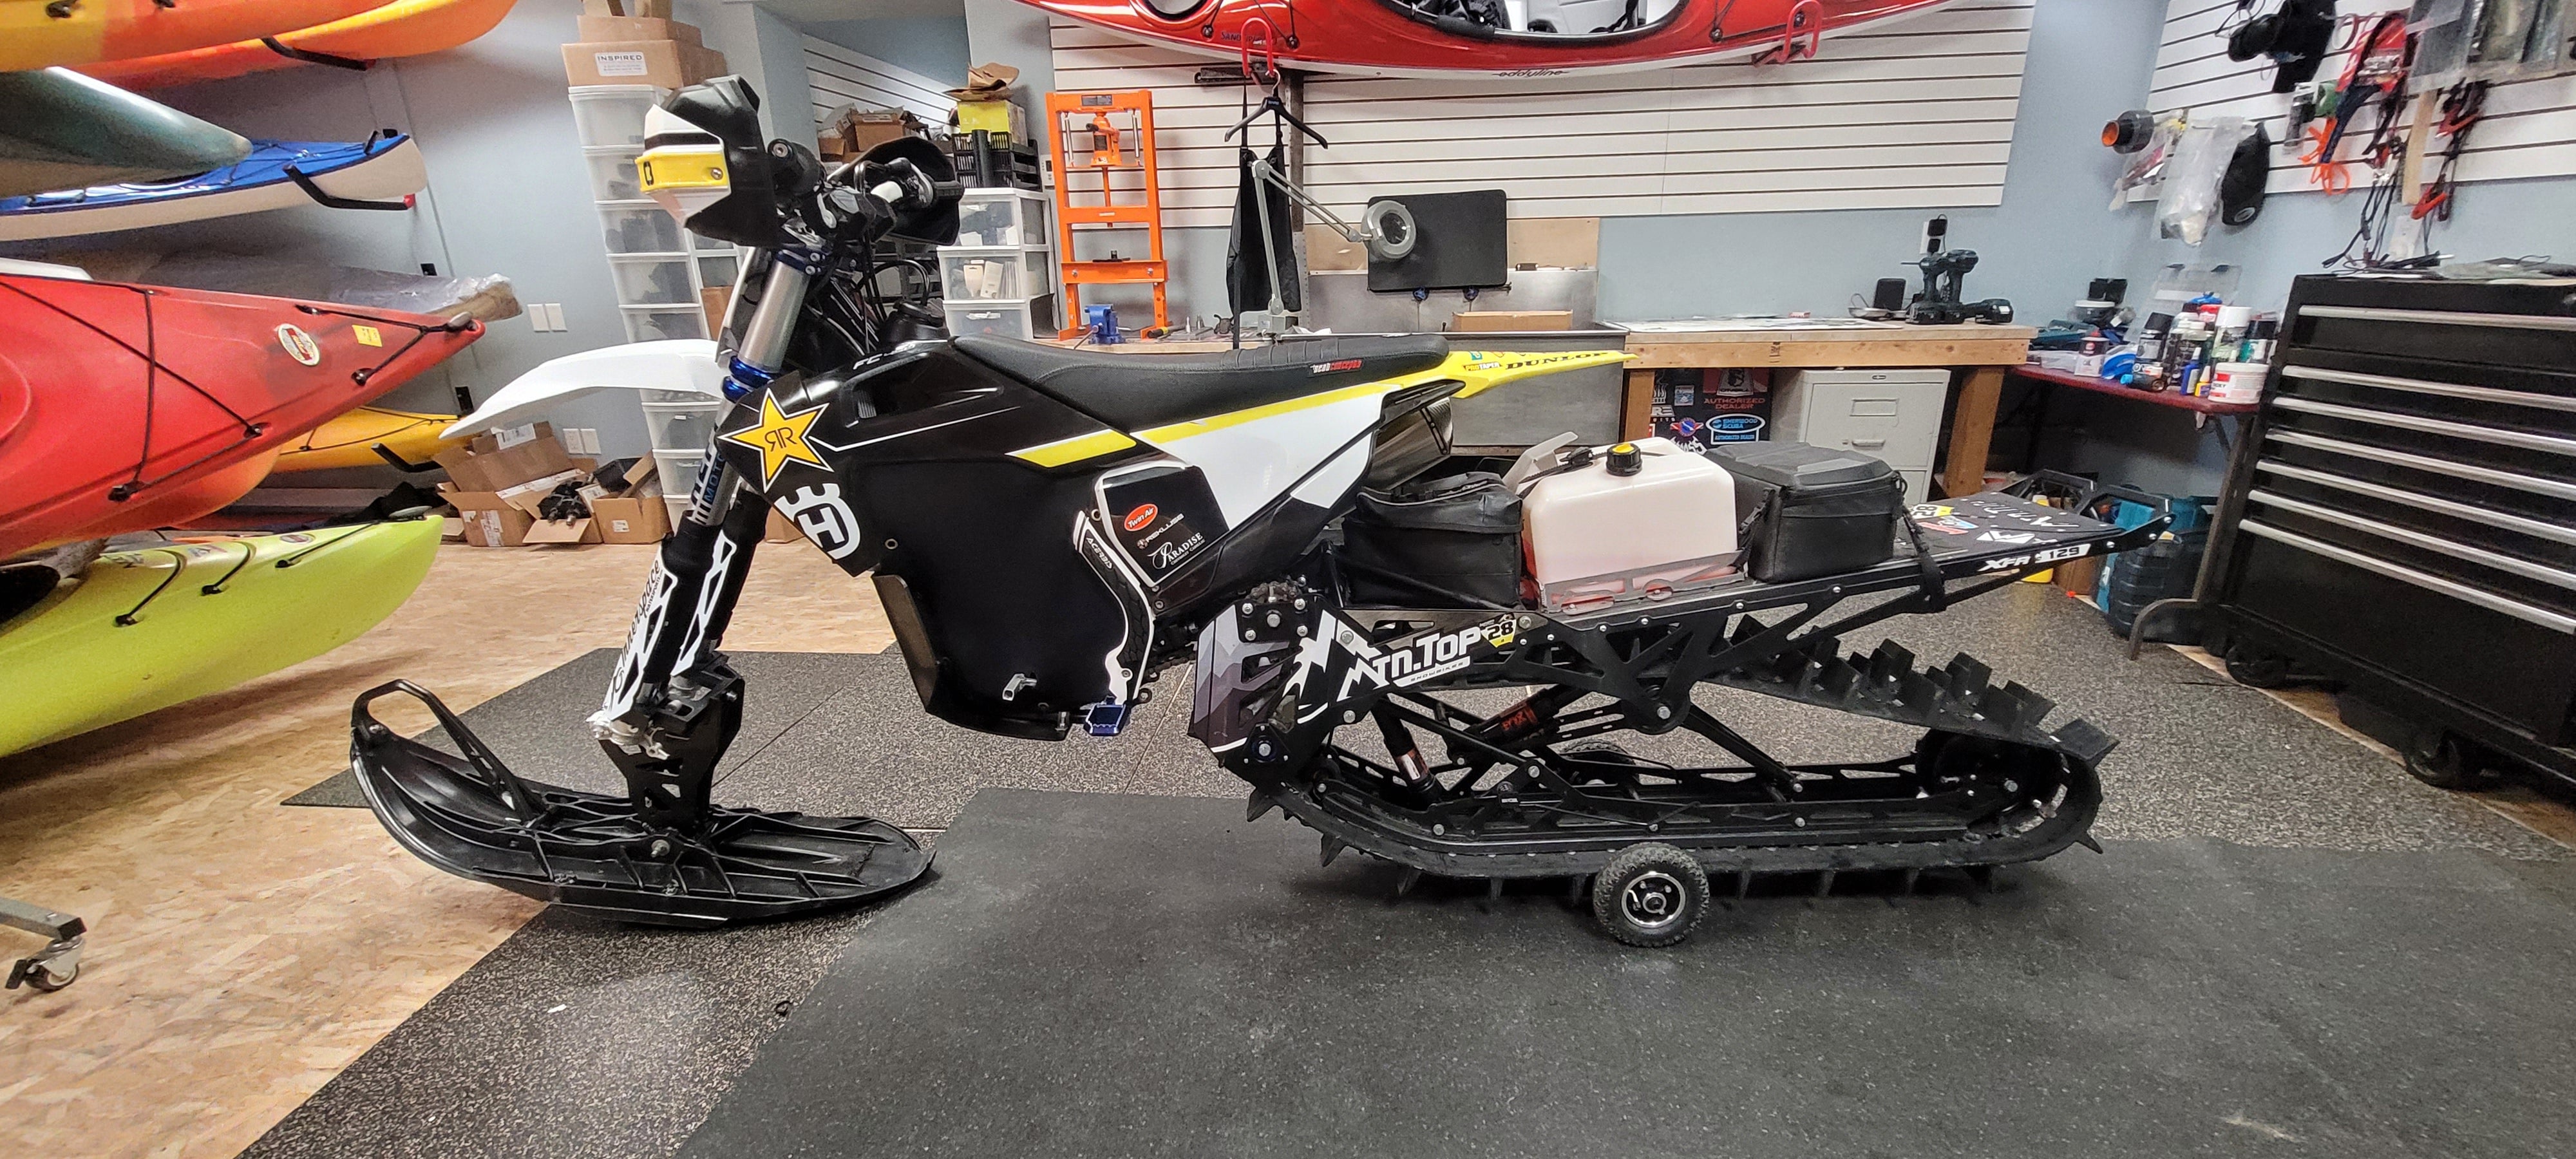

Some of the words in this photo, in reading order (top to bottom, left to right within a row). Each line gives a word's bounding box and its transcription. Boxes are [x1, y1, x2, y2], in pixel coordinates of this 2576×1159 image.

[1492, 68, 1569, 78] eddyline
[1505, 352, 1609, 370] DUNLOP
[1128, 515, 1144, 528] Twin
[1144, 507, 1155, 518] Air
[1147, 532, 1204, 569] PARADISE
[2049, 547, 2080, 560] 129
[1487, 621, 1514, 640] 28
[1410, 661, 1464, 682] SNOWBIKES
